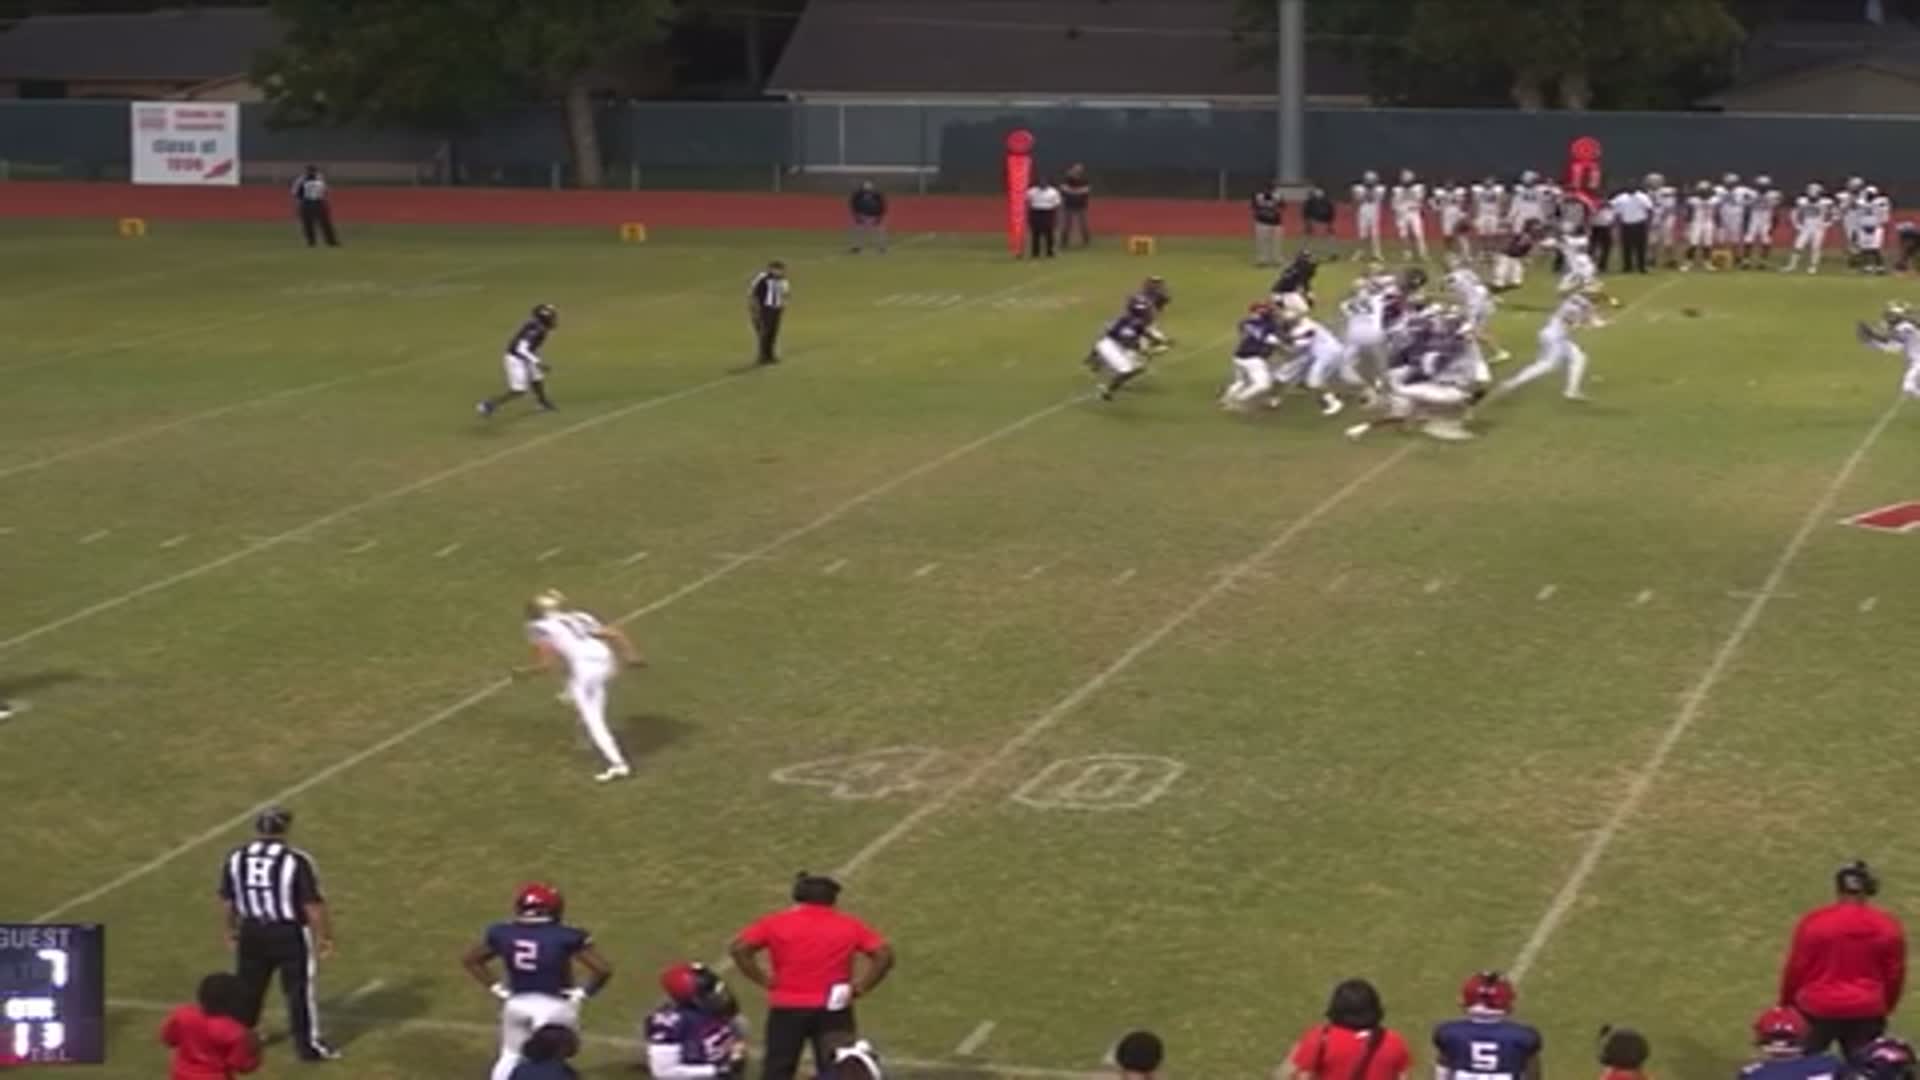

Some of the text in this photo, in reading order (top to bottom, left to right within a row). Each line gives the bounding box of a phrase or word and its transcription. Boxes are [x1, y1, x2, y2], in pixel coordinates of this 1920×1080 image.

[246, 856, 274, 887] H
[513, 938, 538, 971] 2
[1470, 1041, 1500, 1070] 5
